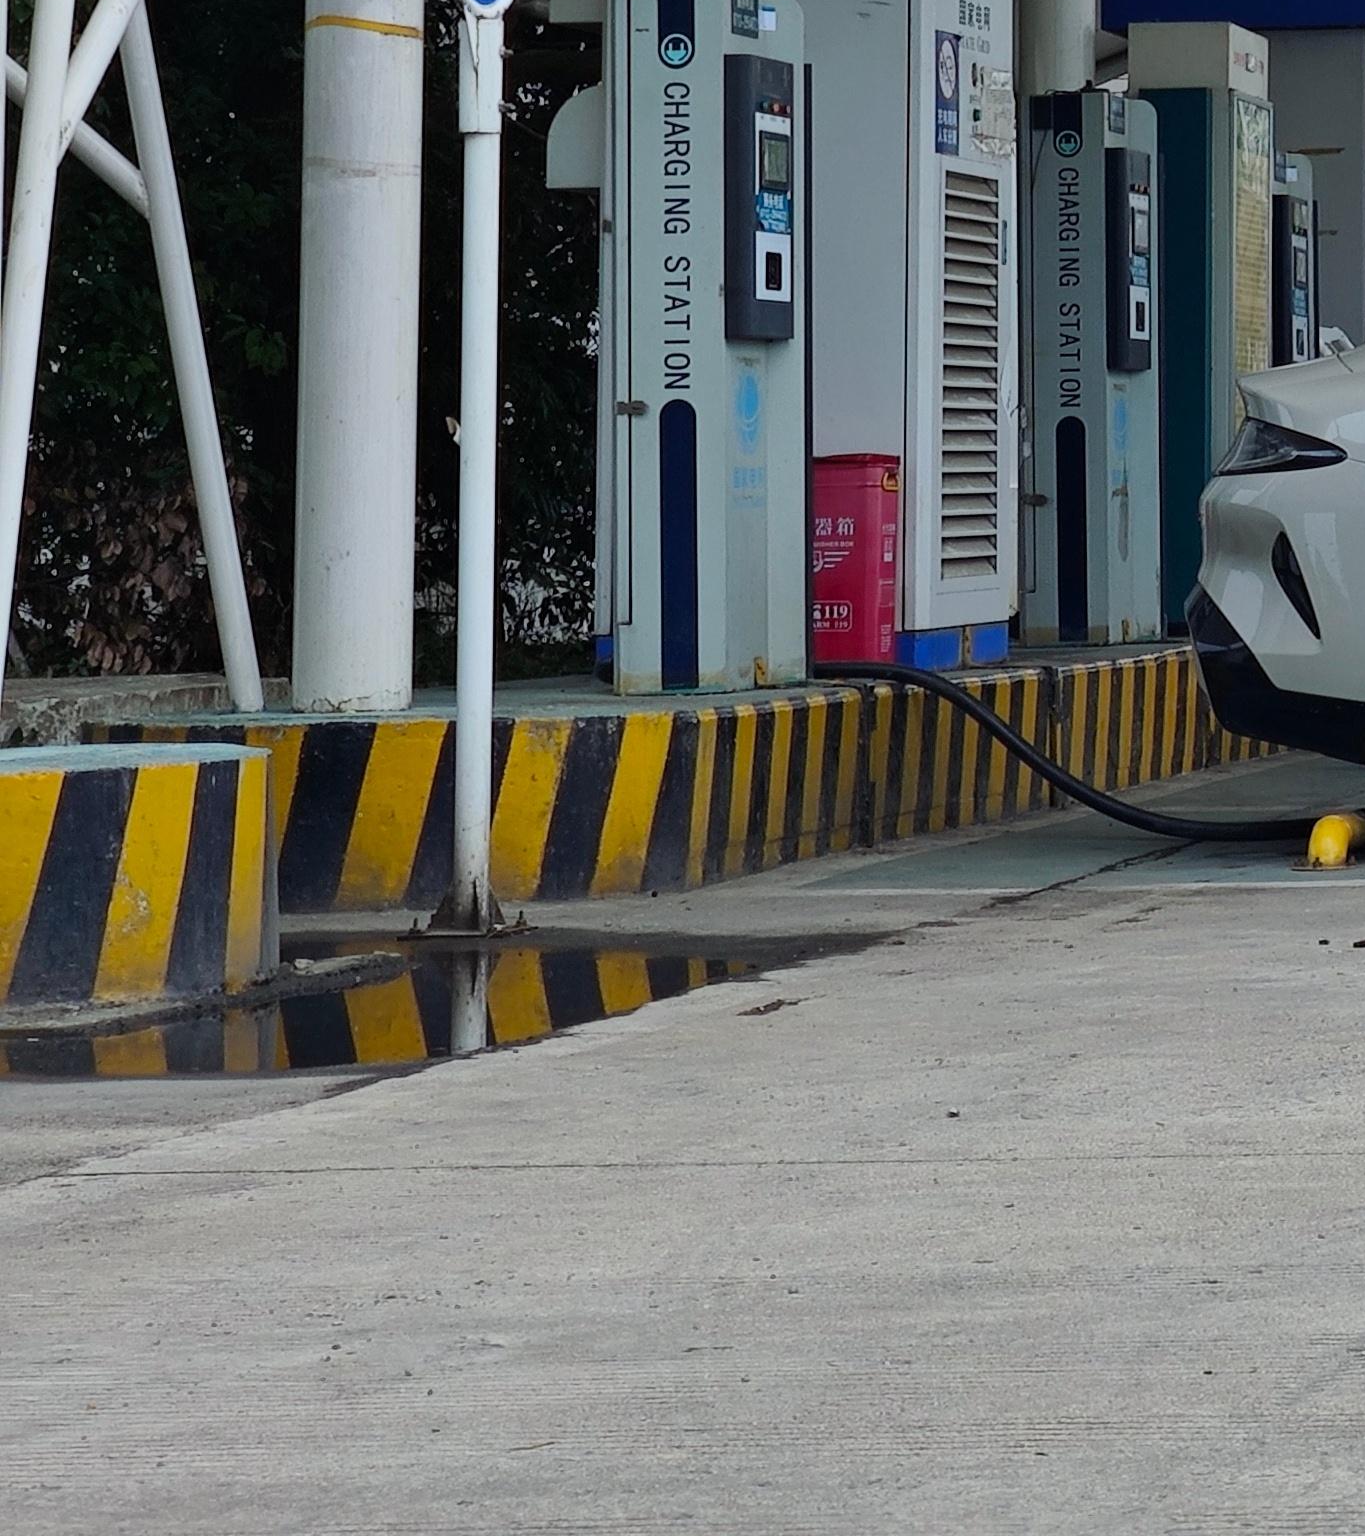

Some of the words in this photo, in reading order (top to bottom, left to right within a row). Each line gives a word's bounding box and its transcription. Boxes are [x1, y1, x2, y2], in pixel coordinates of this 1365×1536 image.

[664, 82, 690, 235] CHARGING
[1058, 167, 1080, 287] CHARGING
[664, 256, 690, 390] STATION
[1059, 302, 1081, 408] STATION
[823, 605, 848, 619] 119
